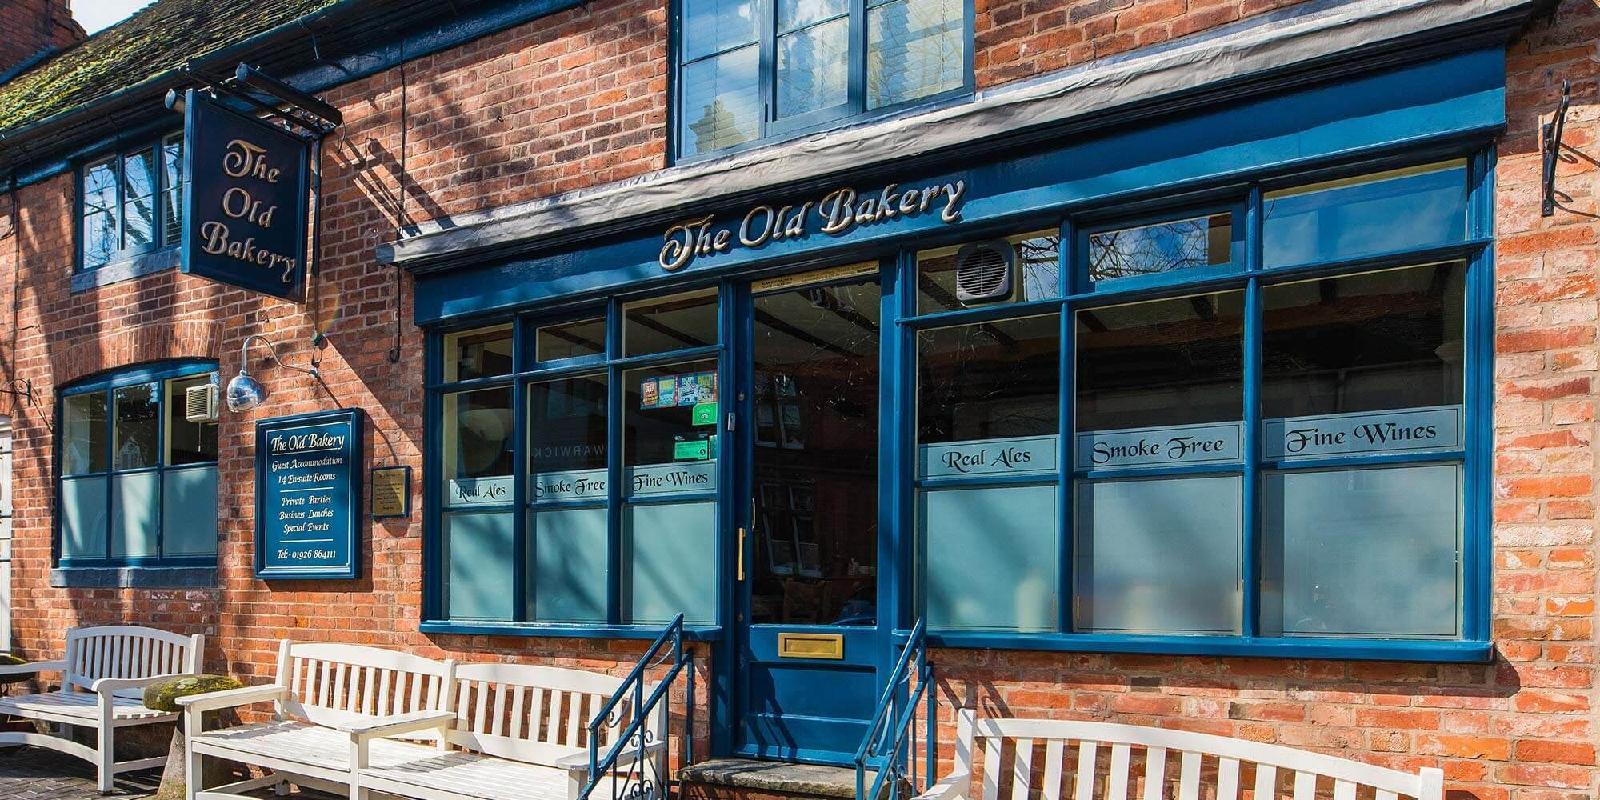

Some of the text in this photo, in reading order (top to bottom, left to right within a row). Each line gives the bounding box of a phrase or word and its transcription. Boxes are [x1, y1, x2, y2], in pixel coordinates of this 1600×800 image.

[222, 139, 280, 183] The
[222, 187, 277, 228] Old
[658, 179, 965, 271] The Old Bakery
[201, 221, 295, 283] Bakery
[270, 432, 345, 452] The Old Bakery
[1285, 422, 1437, 453] Fine Wines
[941, 446, 1031, 474] Real Ales
[1088, 435, 1225, 464] Smoke Free
[271, 456, 343, 473] Guest Accommodation
[278, 475, 287, 485] 14
[313, 472, 337, 483] Rooms
[535, 477, 606, 498] Smoke Free
[632, 471, 709, 492] Fine Wines
[281, 497, 306, 507] Private
[456, 483, 506, 503] Real Ales
[279, 507, 335, 520] Business Lunches
[283, 521, 330, 536] Special Events
[312, 549, 336, 559] 864111
